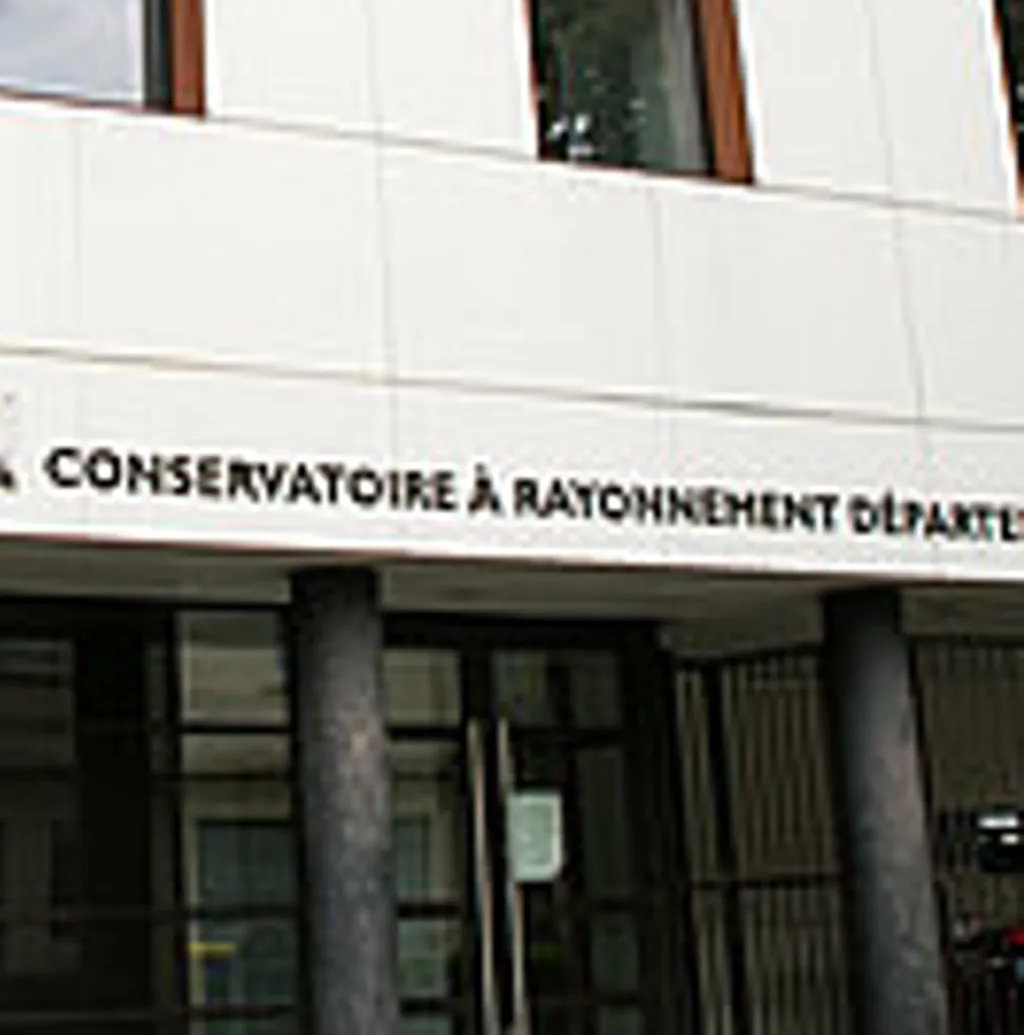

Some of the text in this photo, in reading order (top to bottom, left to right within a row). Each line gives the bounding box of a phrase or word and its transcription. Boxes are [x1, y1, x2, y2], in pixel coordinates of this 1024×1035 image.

[43, 447, 457, 512] CONSERVATOIRE
[467, 463, 503, 515] À
[514, 478, 839, 531] RAYONNEMENT
[848, 489, 1024, 542] DÉPARTE
